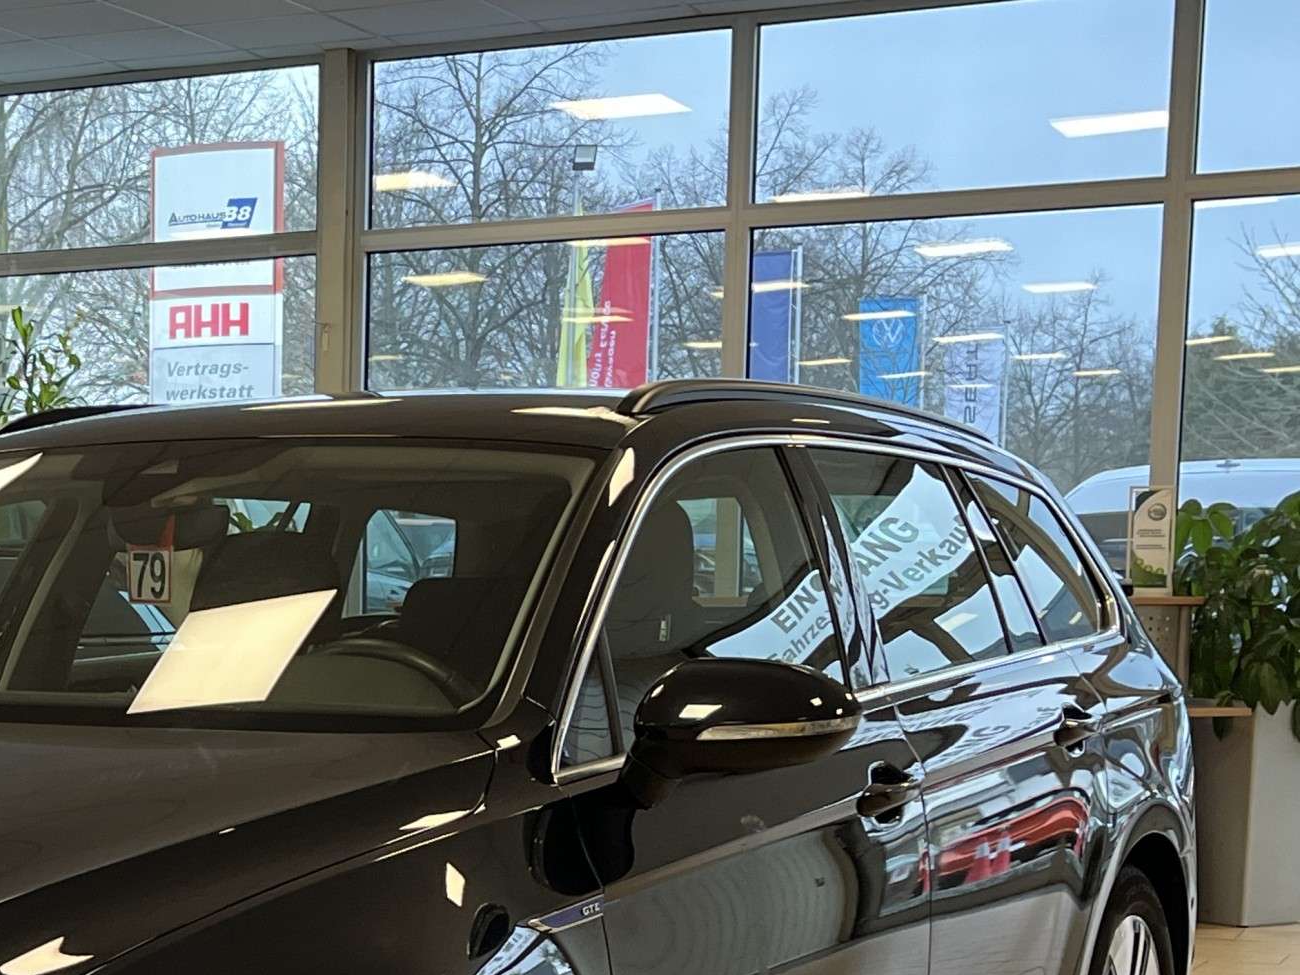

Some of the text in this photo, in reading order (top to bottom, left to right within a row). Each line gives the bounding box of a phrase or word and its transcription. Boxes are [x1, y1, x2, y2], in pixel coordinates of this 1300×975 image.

[169, 303, 249, 339] AHH
[166, 361, 249, 378] Vertrags-
[165, 384, 254, 401] werkstatt
[132, 551, 166, 599] 79
[581, 902, 600, 916] GTE
